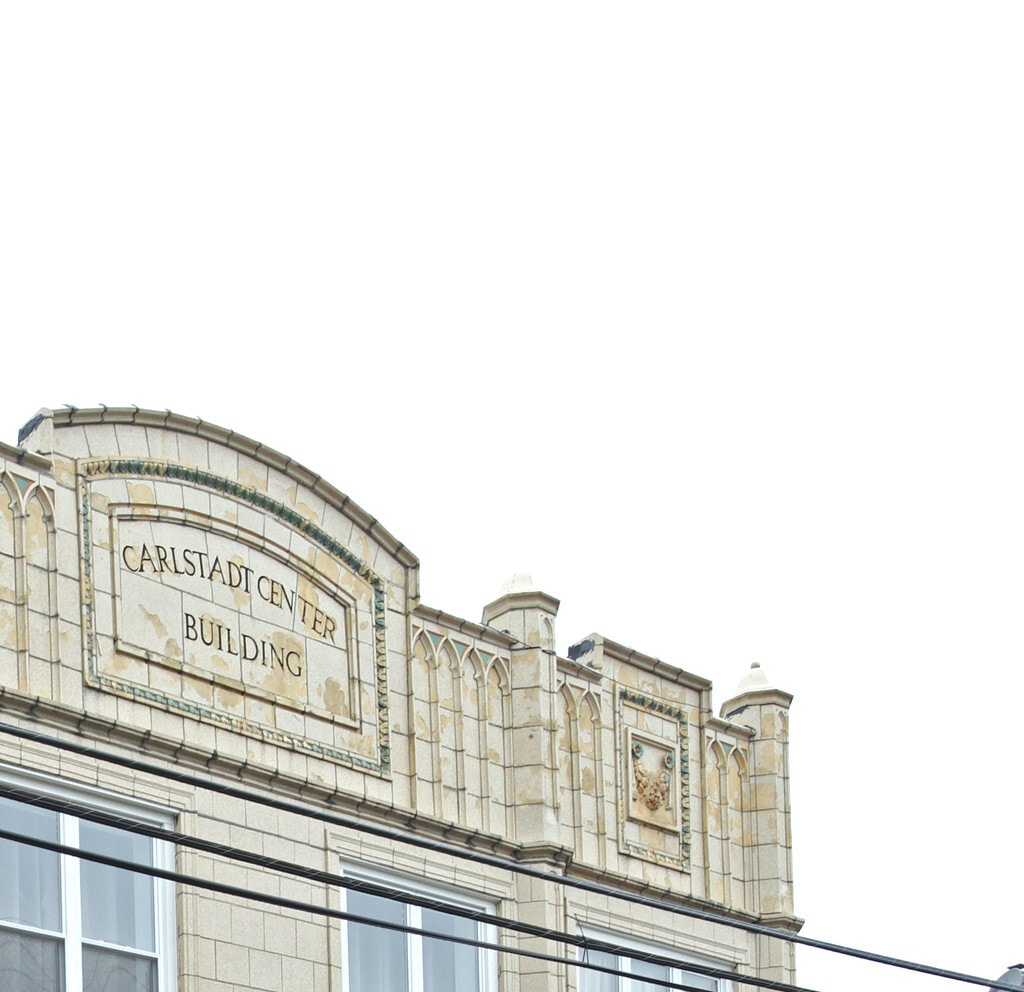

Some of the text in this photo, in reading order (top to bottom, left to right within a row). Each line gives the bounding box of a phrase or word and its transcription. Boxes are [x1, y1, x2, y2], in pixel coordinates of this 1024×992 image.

[122, 543, 337, 644] CARLSTADT CENTER
[184, 612, 303, 678] BUILDING
